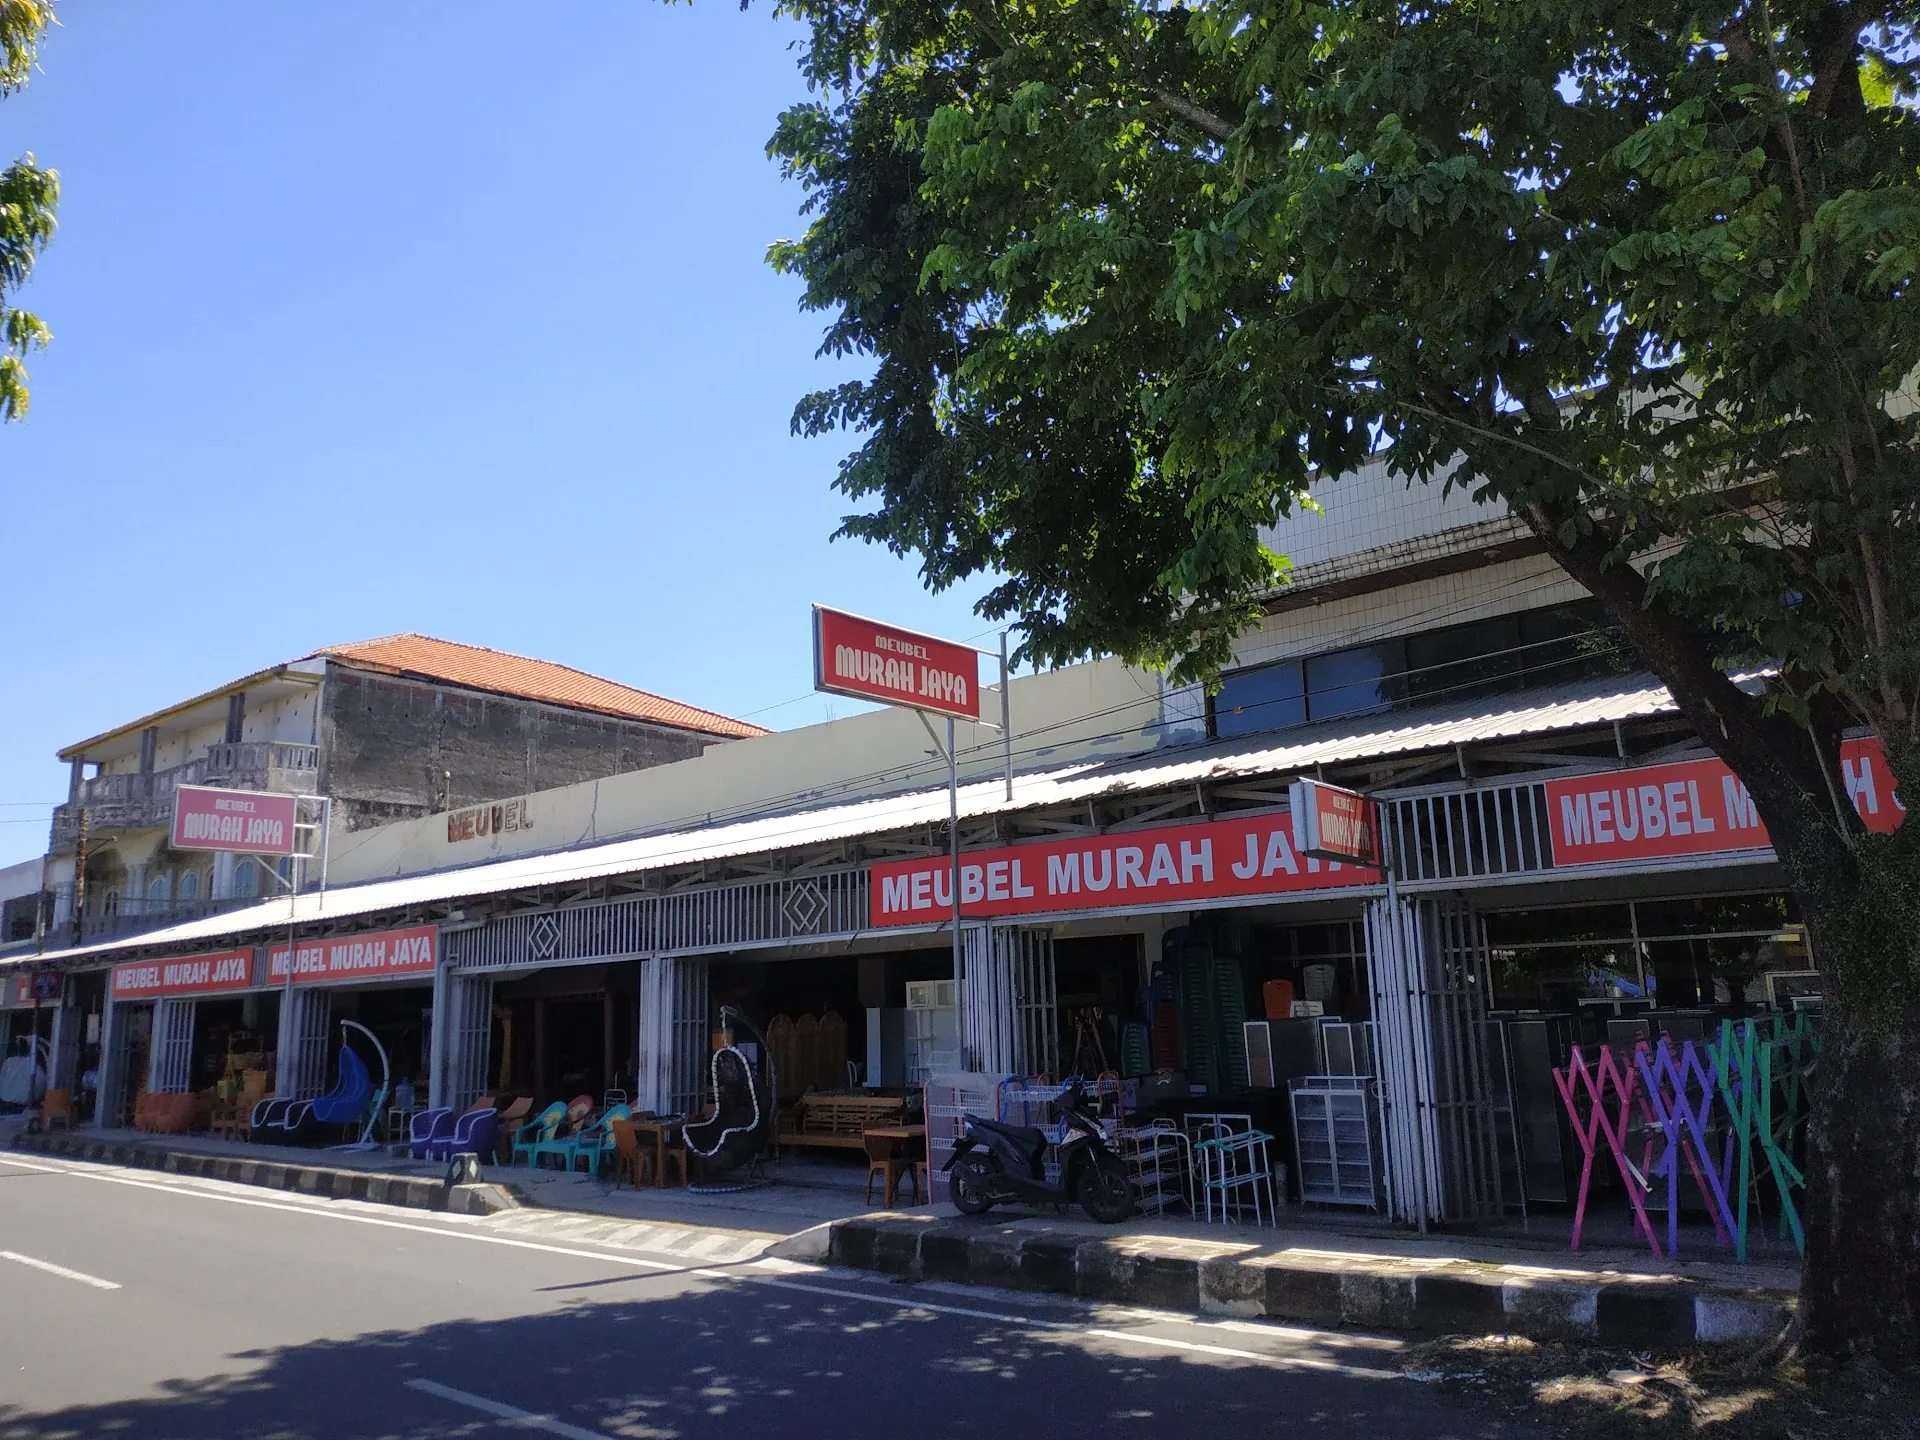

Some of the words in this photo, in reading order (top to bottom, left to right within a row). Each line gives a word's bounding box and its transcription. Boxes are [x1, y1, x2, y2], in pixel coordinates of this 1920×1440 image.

[875, 635, 931, 661] MEUBEL
[835, 644, 915, 693] MURAH
[919, 666, 967, 705] JAYA
[215, 799, 256, 813] MEUBEL
[447, 799, 533, 843] MEUBEL
[1332, 795, 1354, 812] MEUBEL
[1561, 779, 1715, 846] MEUBEL
[184, 813, 243, 842] MURAH
[245, 818, 283, 845] JAYA
[1321, 811, 1351, 847] MURAH
[882, 859, 1034, 913] MEUBEL
[1047, 838, 1214, 896] MURAH
[1231, 831, 1366, 879] JA
[116, 966, 160, 990] MEUBEL
[163, 962, 208, 986] MURAH
[212, 958, 245, 981] JAYA
[272, 946, 326, 976] MEUBEL
[330, 942, 385, 970] MURAH
[390, 936, 431, 966] JAYA
